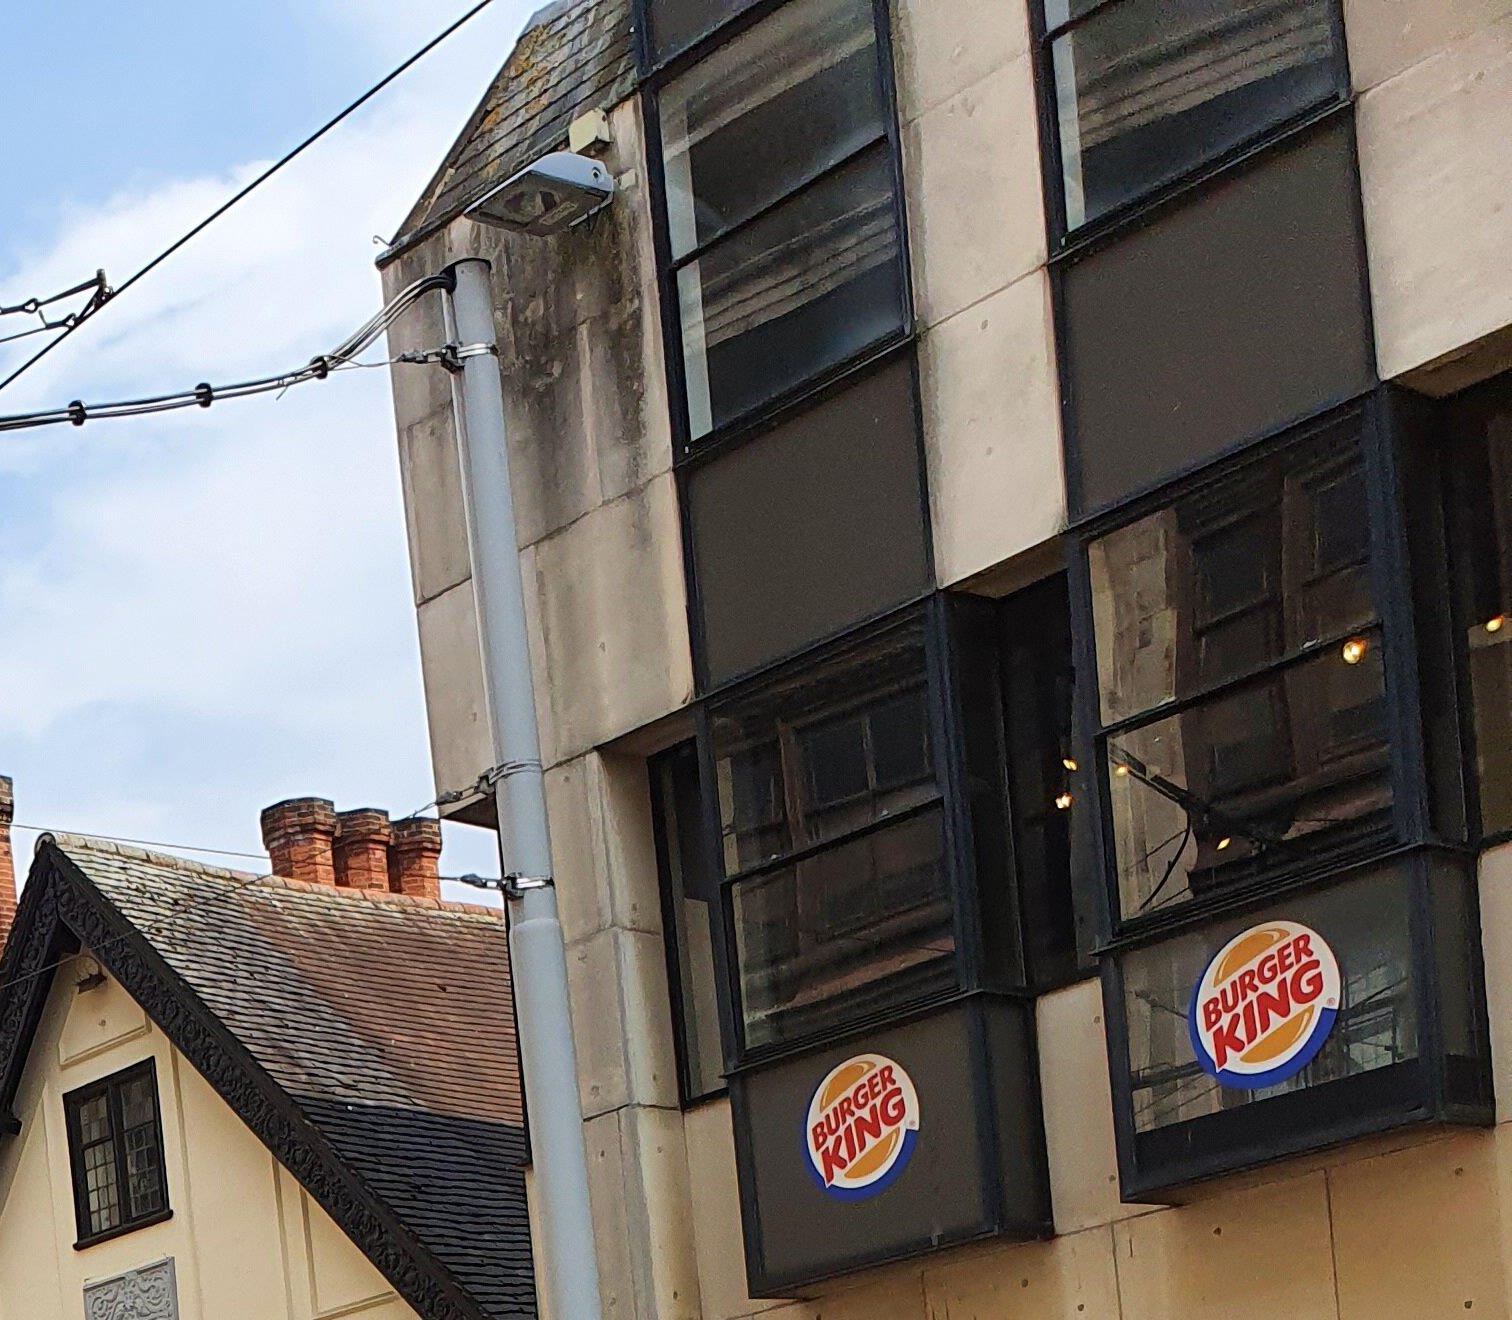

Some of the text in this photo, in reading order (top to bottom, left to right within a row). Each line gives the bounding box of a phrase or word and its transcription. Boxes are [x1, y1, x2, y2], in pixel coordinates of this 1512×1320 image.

[1202, 934, 1314, 1032] BURGER
[1212, 959, 1324, 1069] KING
[811, 1065, 896, 1152] BURGER
[821, 1087, 906, 1184] KING
